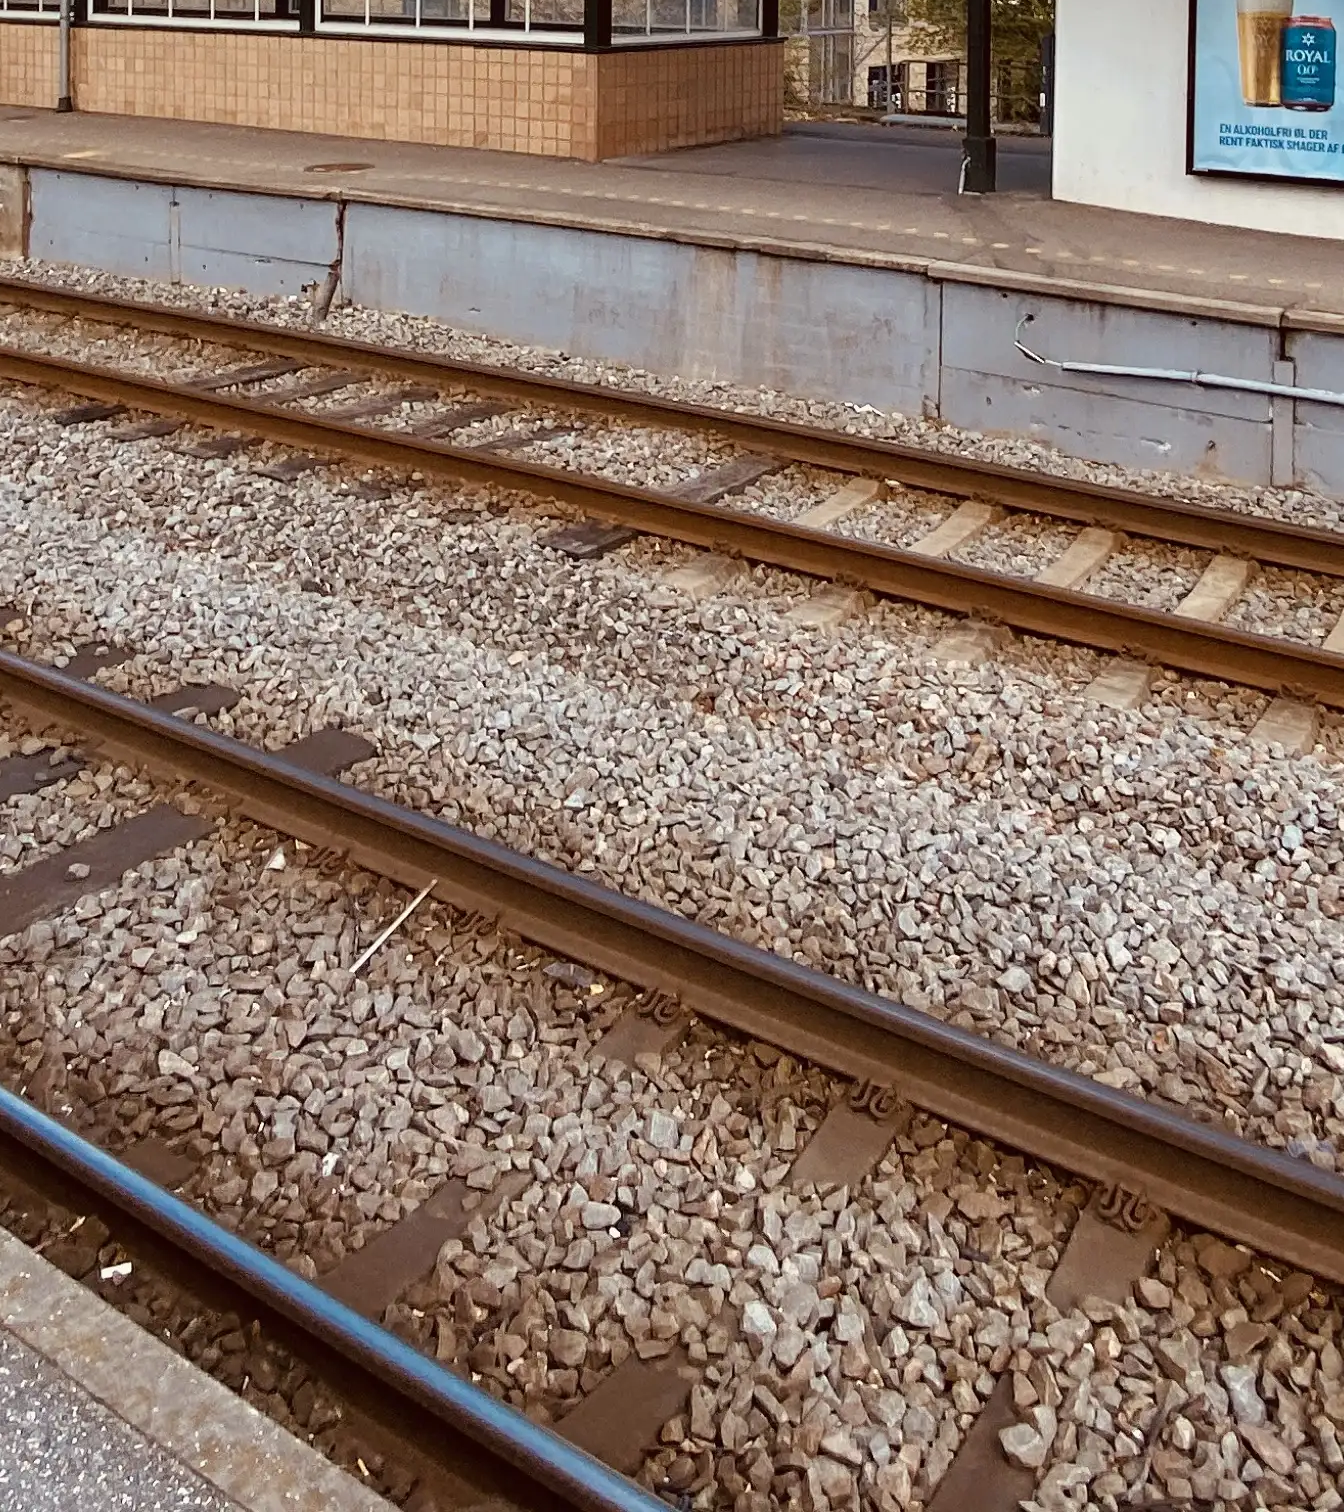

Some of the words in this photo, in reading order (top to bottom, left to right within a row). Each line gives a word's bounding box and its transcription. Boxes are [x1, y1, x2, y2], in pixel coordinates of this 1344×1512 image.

[1285, 49, 1331, 63] ROYAL
[1219, 123, 1232, 134] EN
[1233, 124, 1292, 138] ALKOHOLFRI
[1309, 129, 1328, 140] DER
[1219, 136, 1243, 147] RENT
[1245, 137, 1285, 150] FAKTISK
[1287, 141, 1325, 152] SMAGER
[1327, 143, 1339, 154] AF
